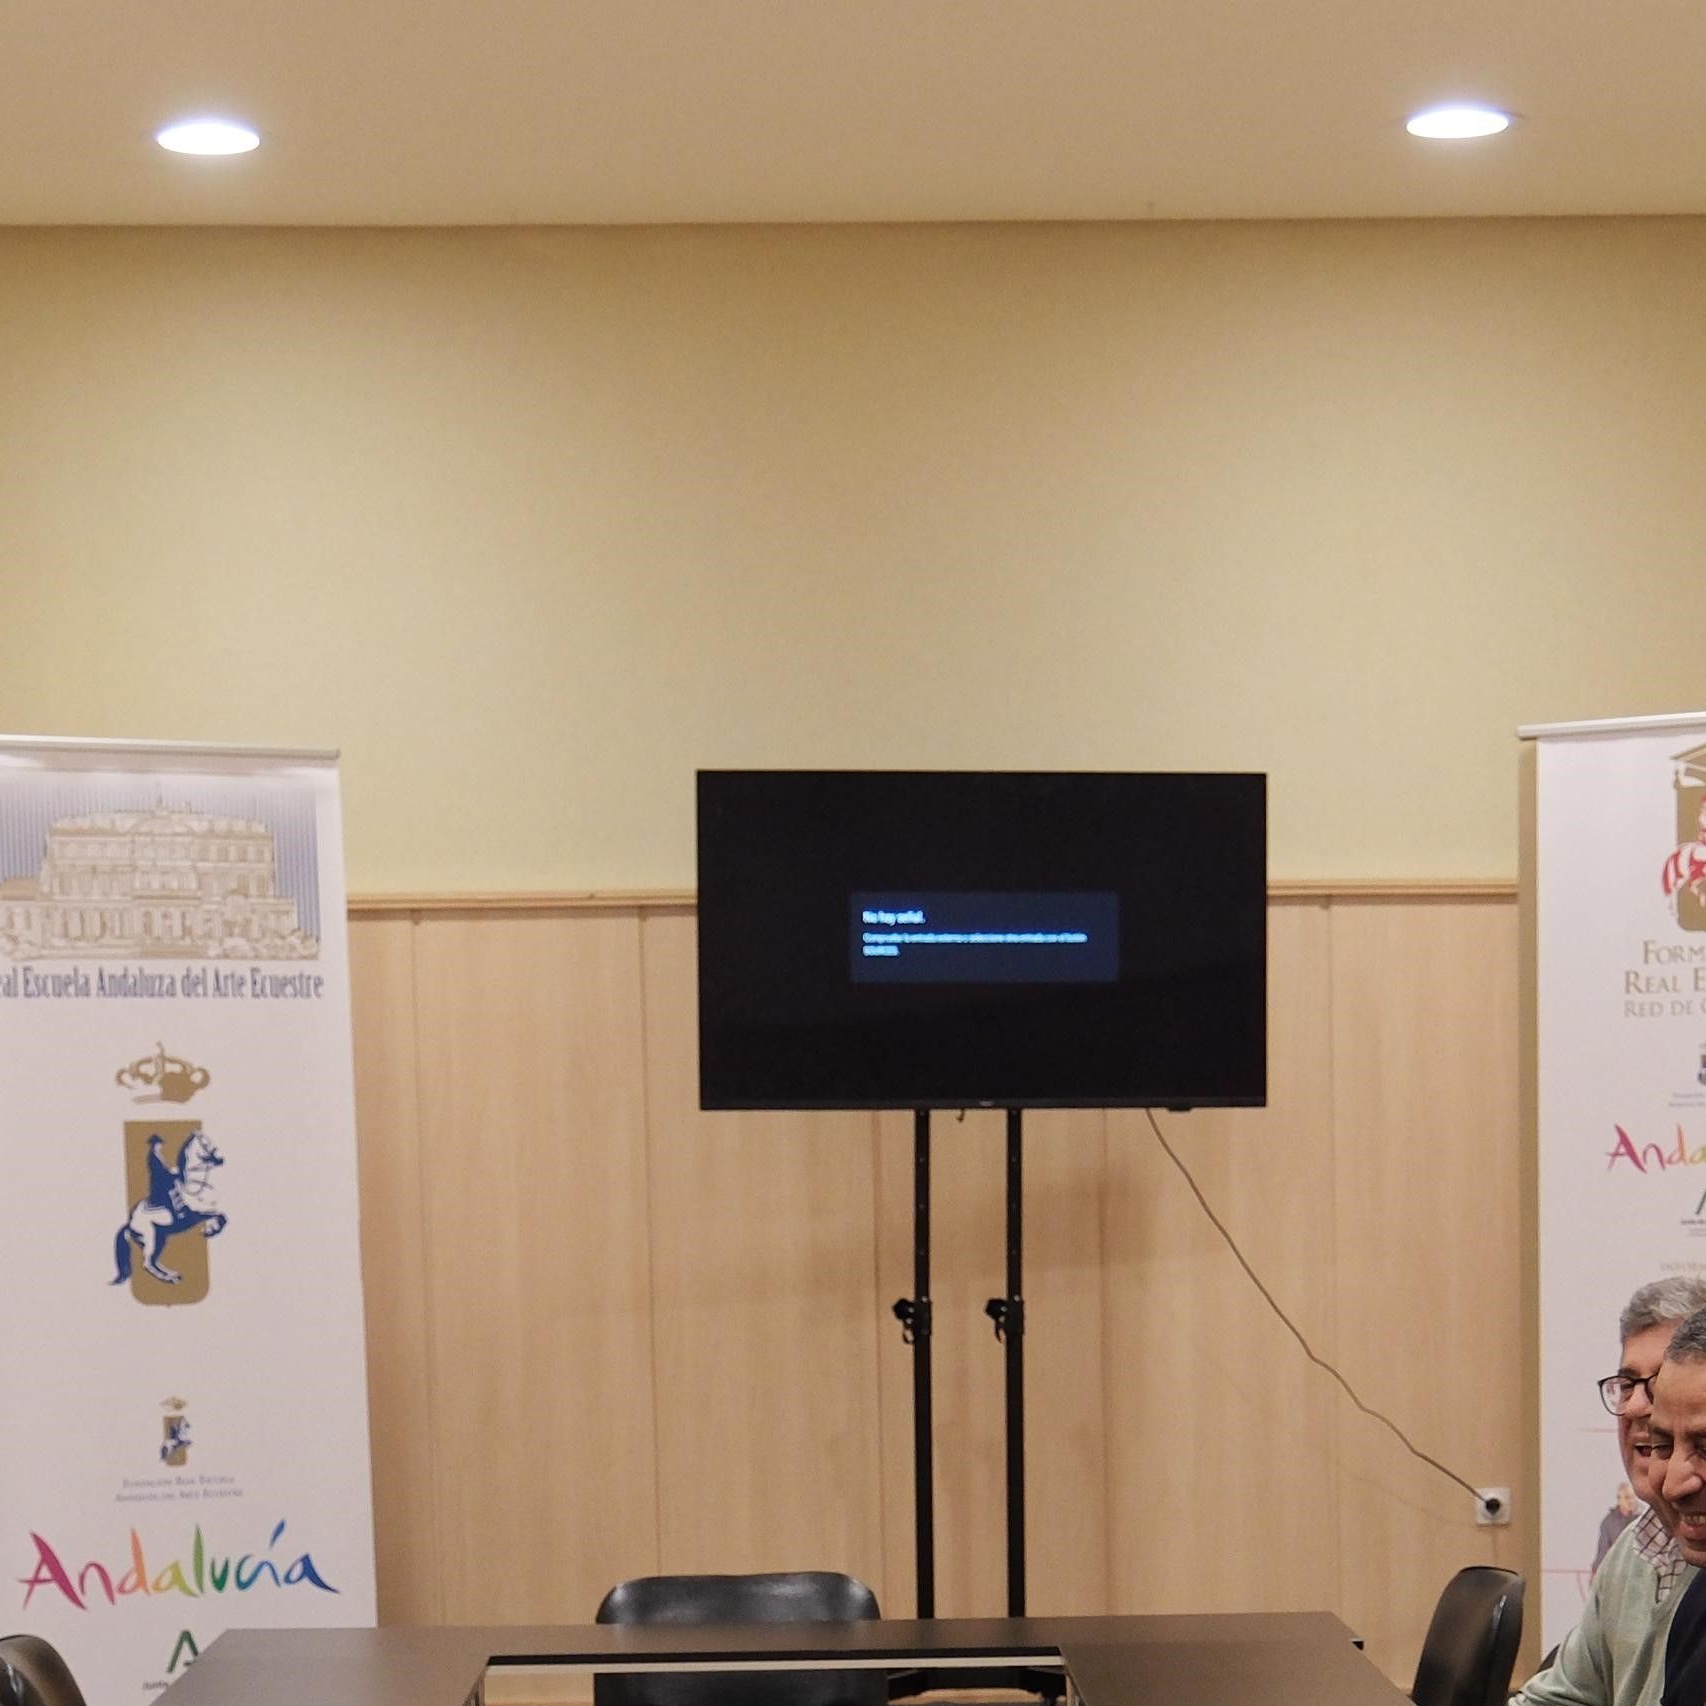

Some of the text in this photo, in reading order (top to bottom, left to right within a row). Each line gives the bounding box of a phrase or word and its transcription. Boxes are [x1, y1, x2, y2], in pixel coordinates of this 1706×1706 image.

[22, 966, 91, 998] Escuela
[96, 966, 176, 998] Andaluza
[181, 966, 208, 998] del
[212, 967, 247, 998] Arte
[250, 967, 325, 999] Ecuestre
[1624, 970, 1681, 995] REAL
[1624, 1001, 1665, 1018] RED
[1670, 1000, 1694, 1017] DE
[19, 1519, 340, 1610] Andalucía
